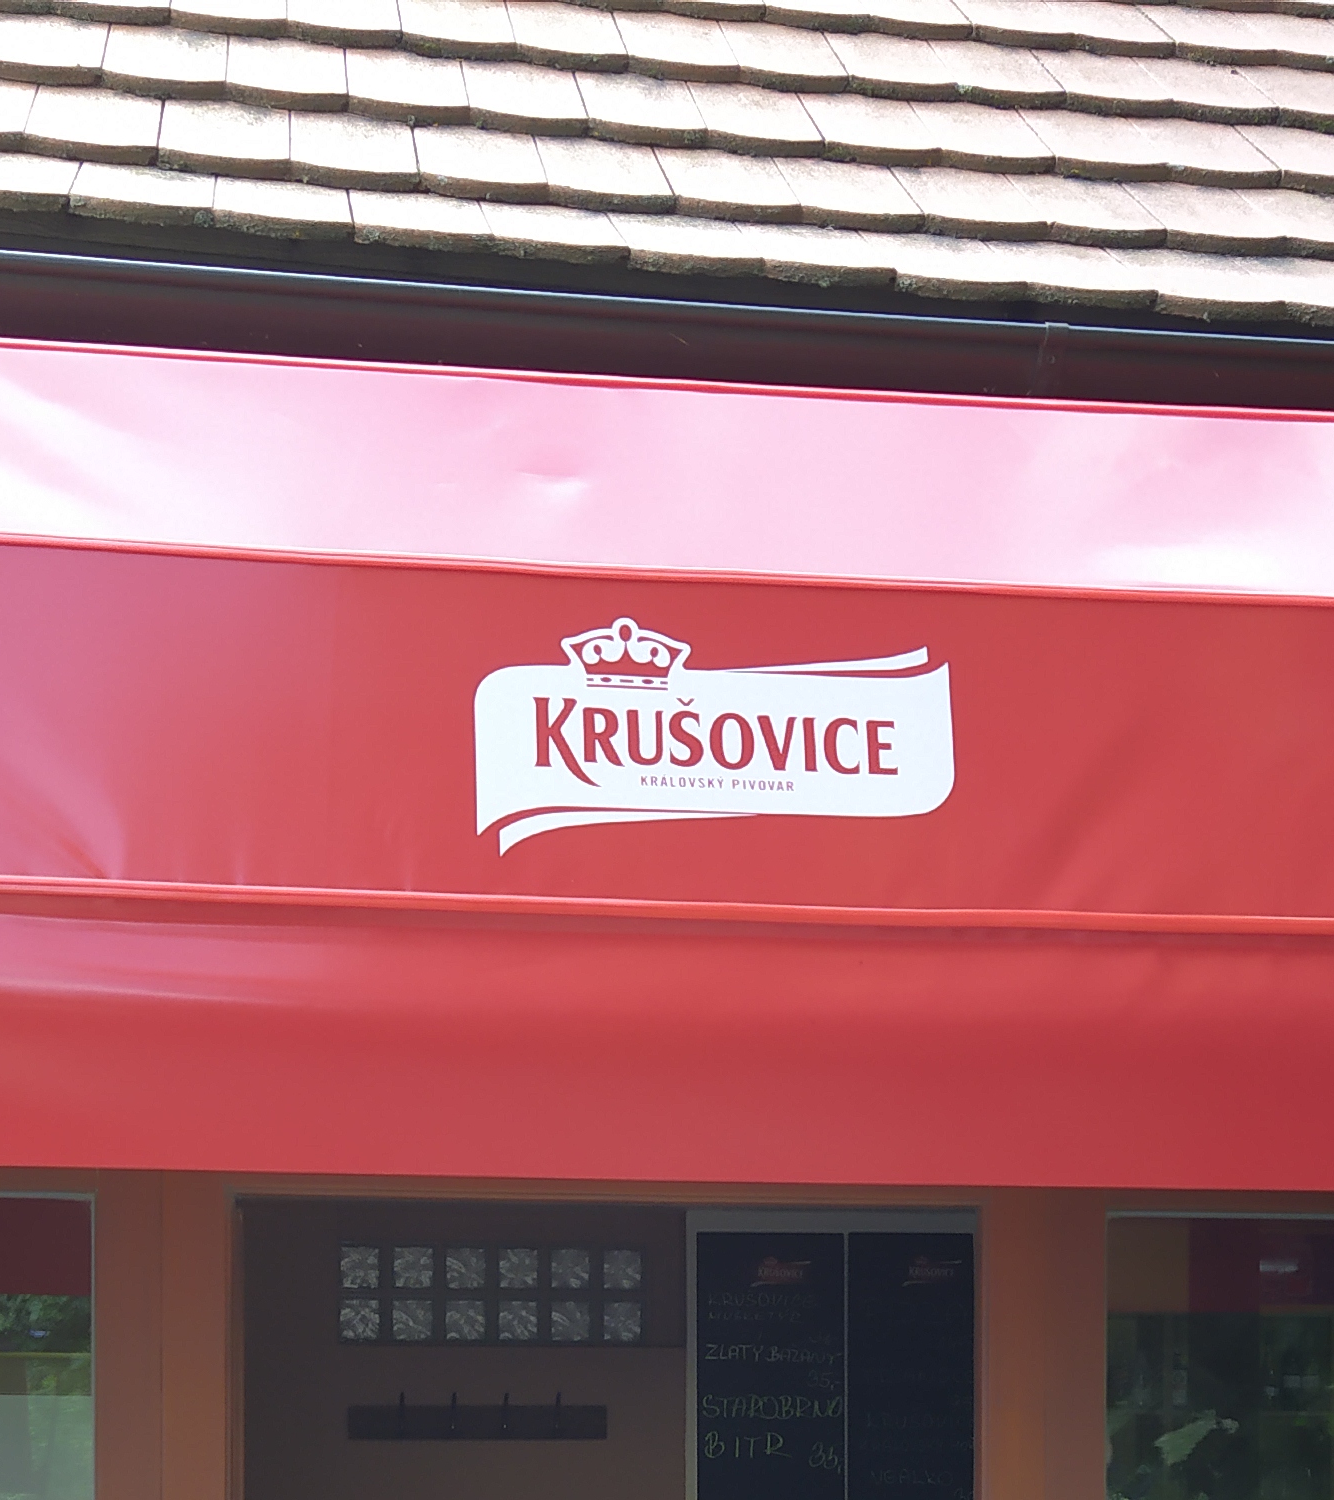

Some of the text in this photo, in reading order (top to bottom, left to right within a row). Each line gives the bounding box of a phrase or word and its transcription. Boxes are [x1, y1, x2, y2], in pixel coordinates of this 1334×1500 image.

[533, 697, 899, 788] KRUŠOVICE
[640, 774, 795, 792] KRÁLOVSKÝ PIVOVAR
